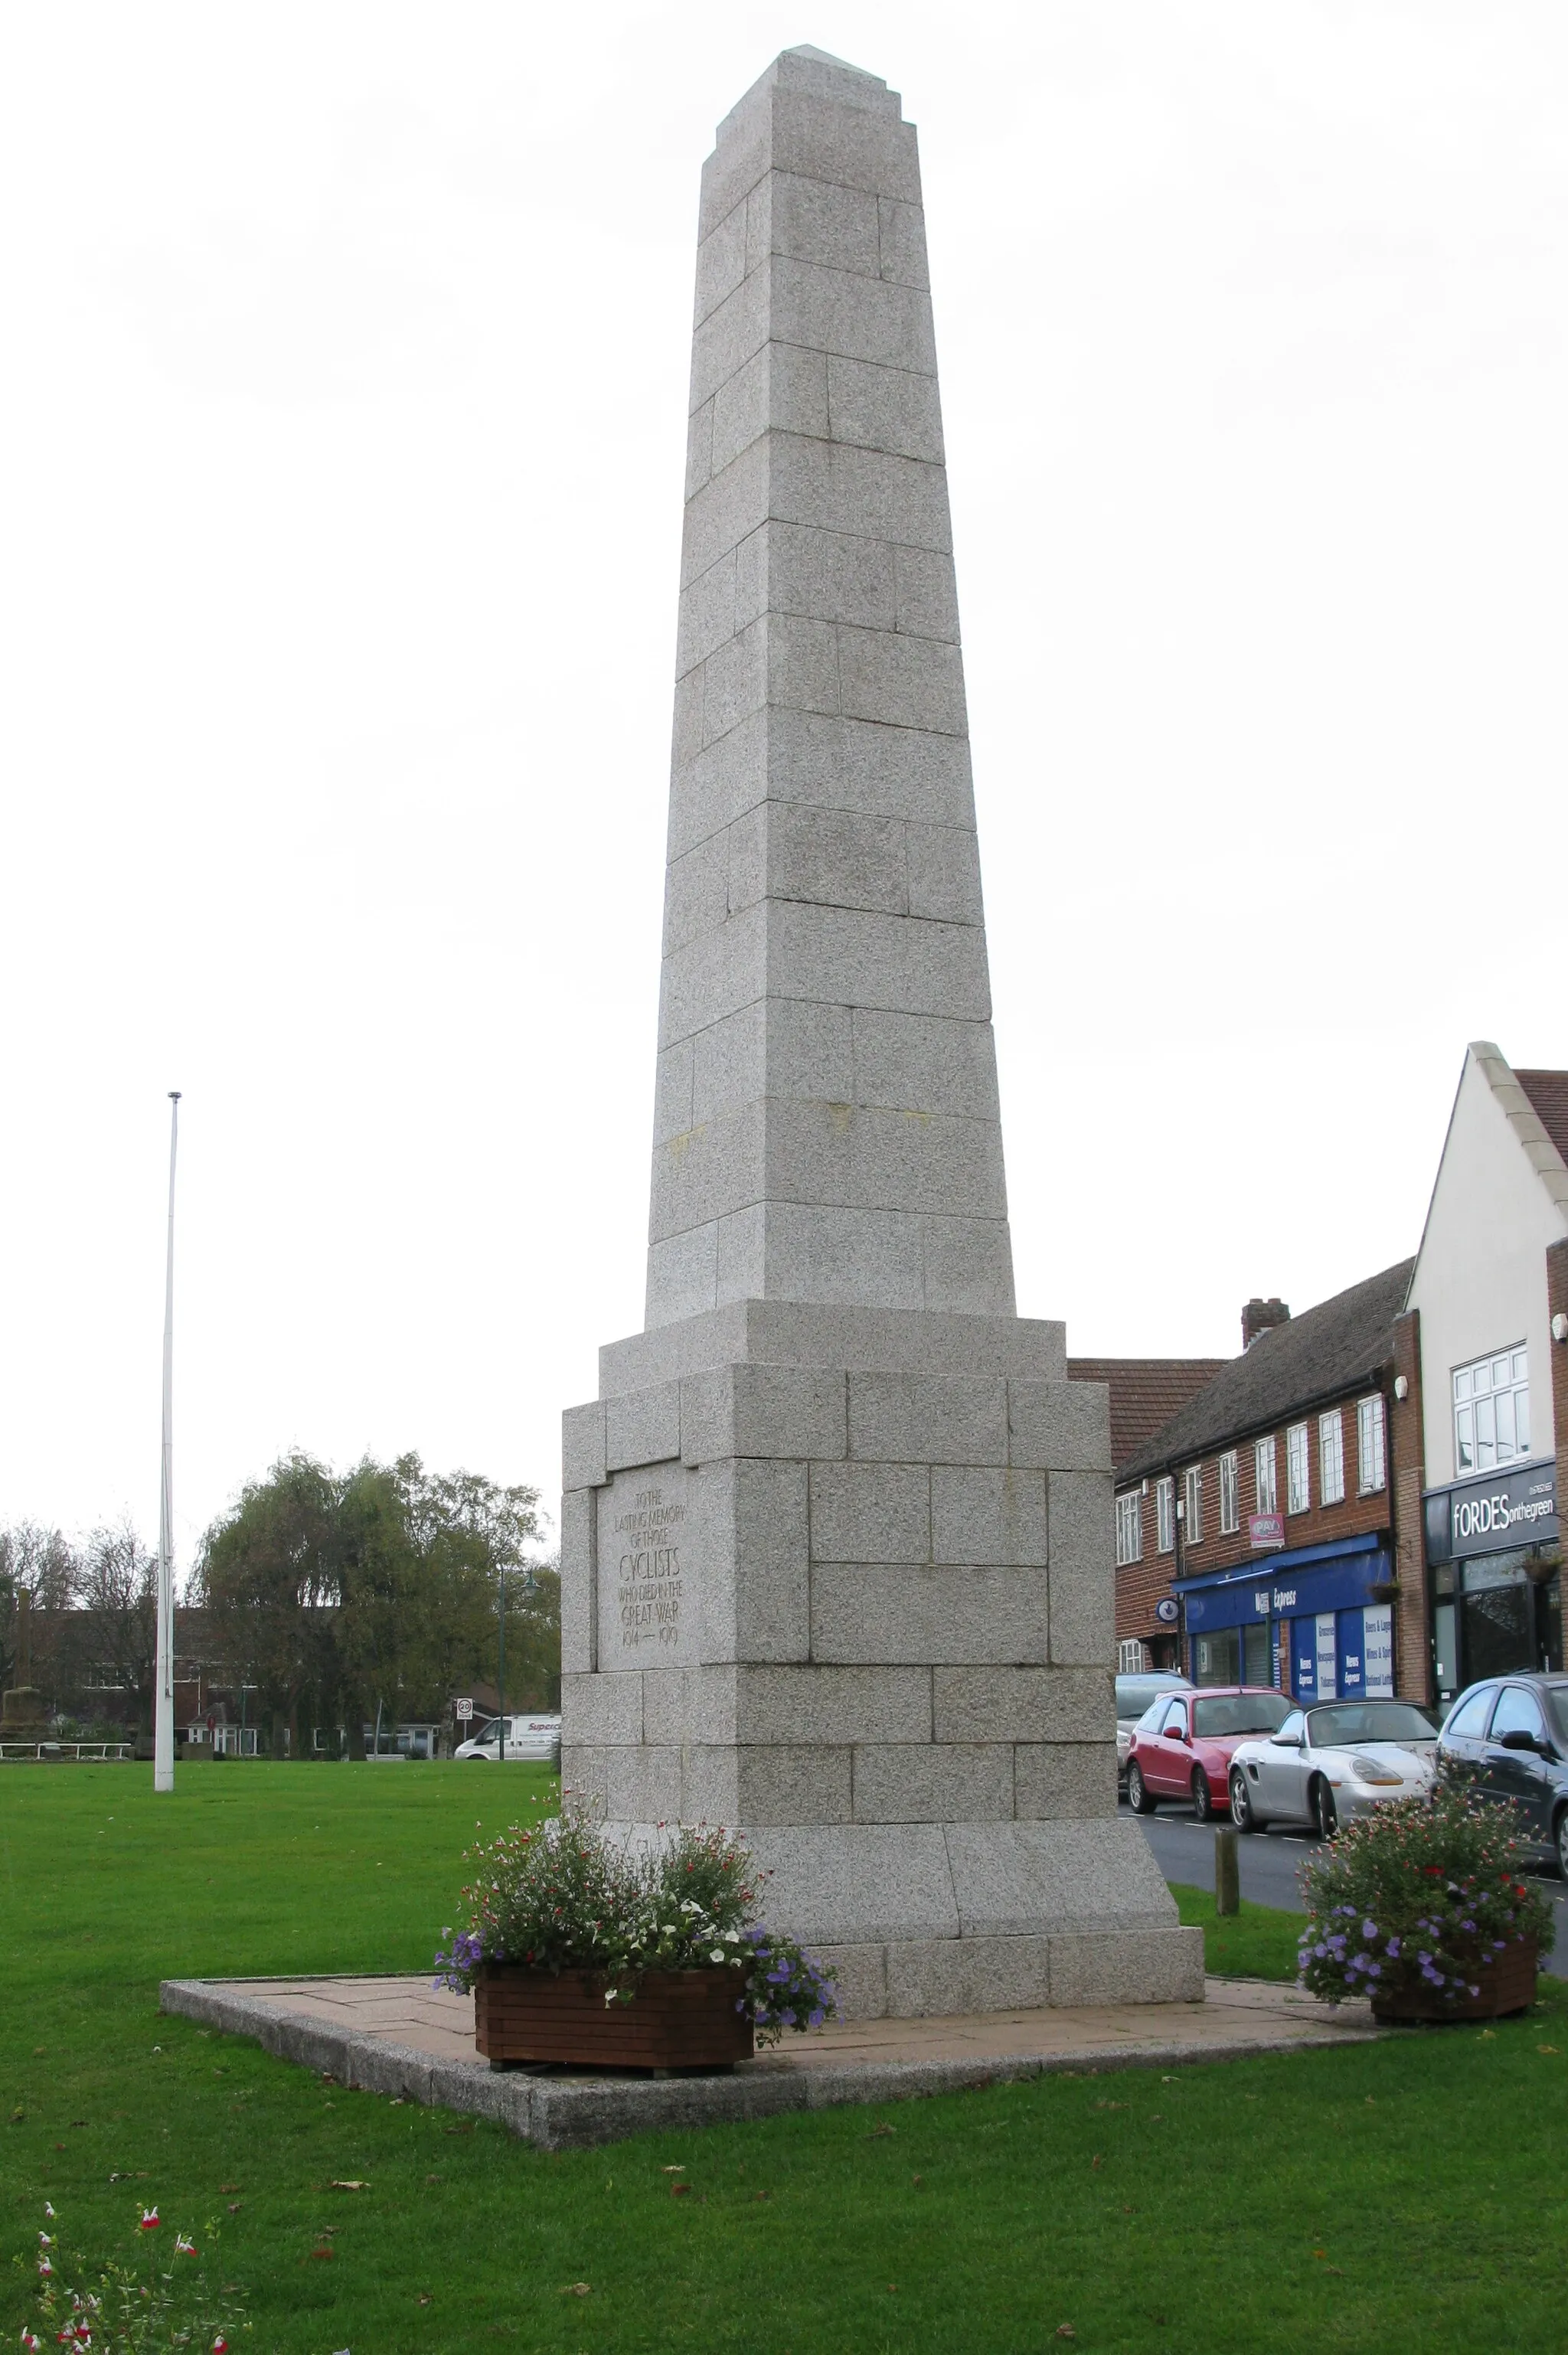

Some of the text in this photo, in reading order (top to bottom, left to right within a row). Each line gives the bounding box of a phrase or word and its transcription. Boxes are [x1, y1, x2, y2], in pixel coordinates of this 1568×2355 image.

[635, 1489, 663, 1509] TO THE
[615, 1504, 685, 1533] LASTING MEMORY
[631, 1528, 668, 1549] OF THOSE
[619, 1547, 680, 1582] CYCLISTS
[619, 1579, 683, 1602] WHO DIED IN THE
[1273, 1587, 1297, 1612] Express
[622, 1600, 680, 1627] GREAT WAR
[622, 1628, 639, 1648] 1914
[658, 1625, 678, 1646] 1919
